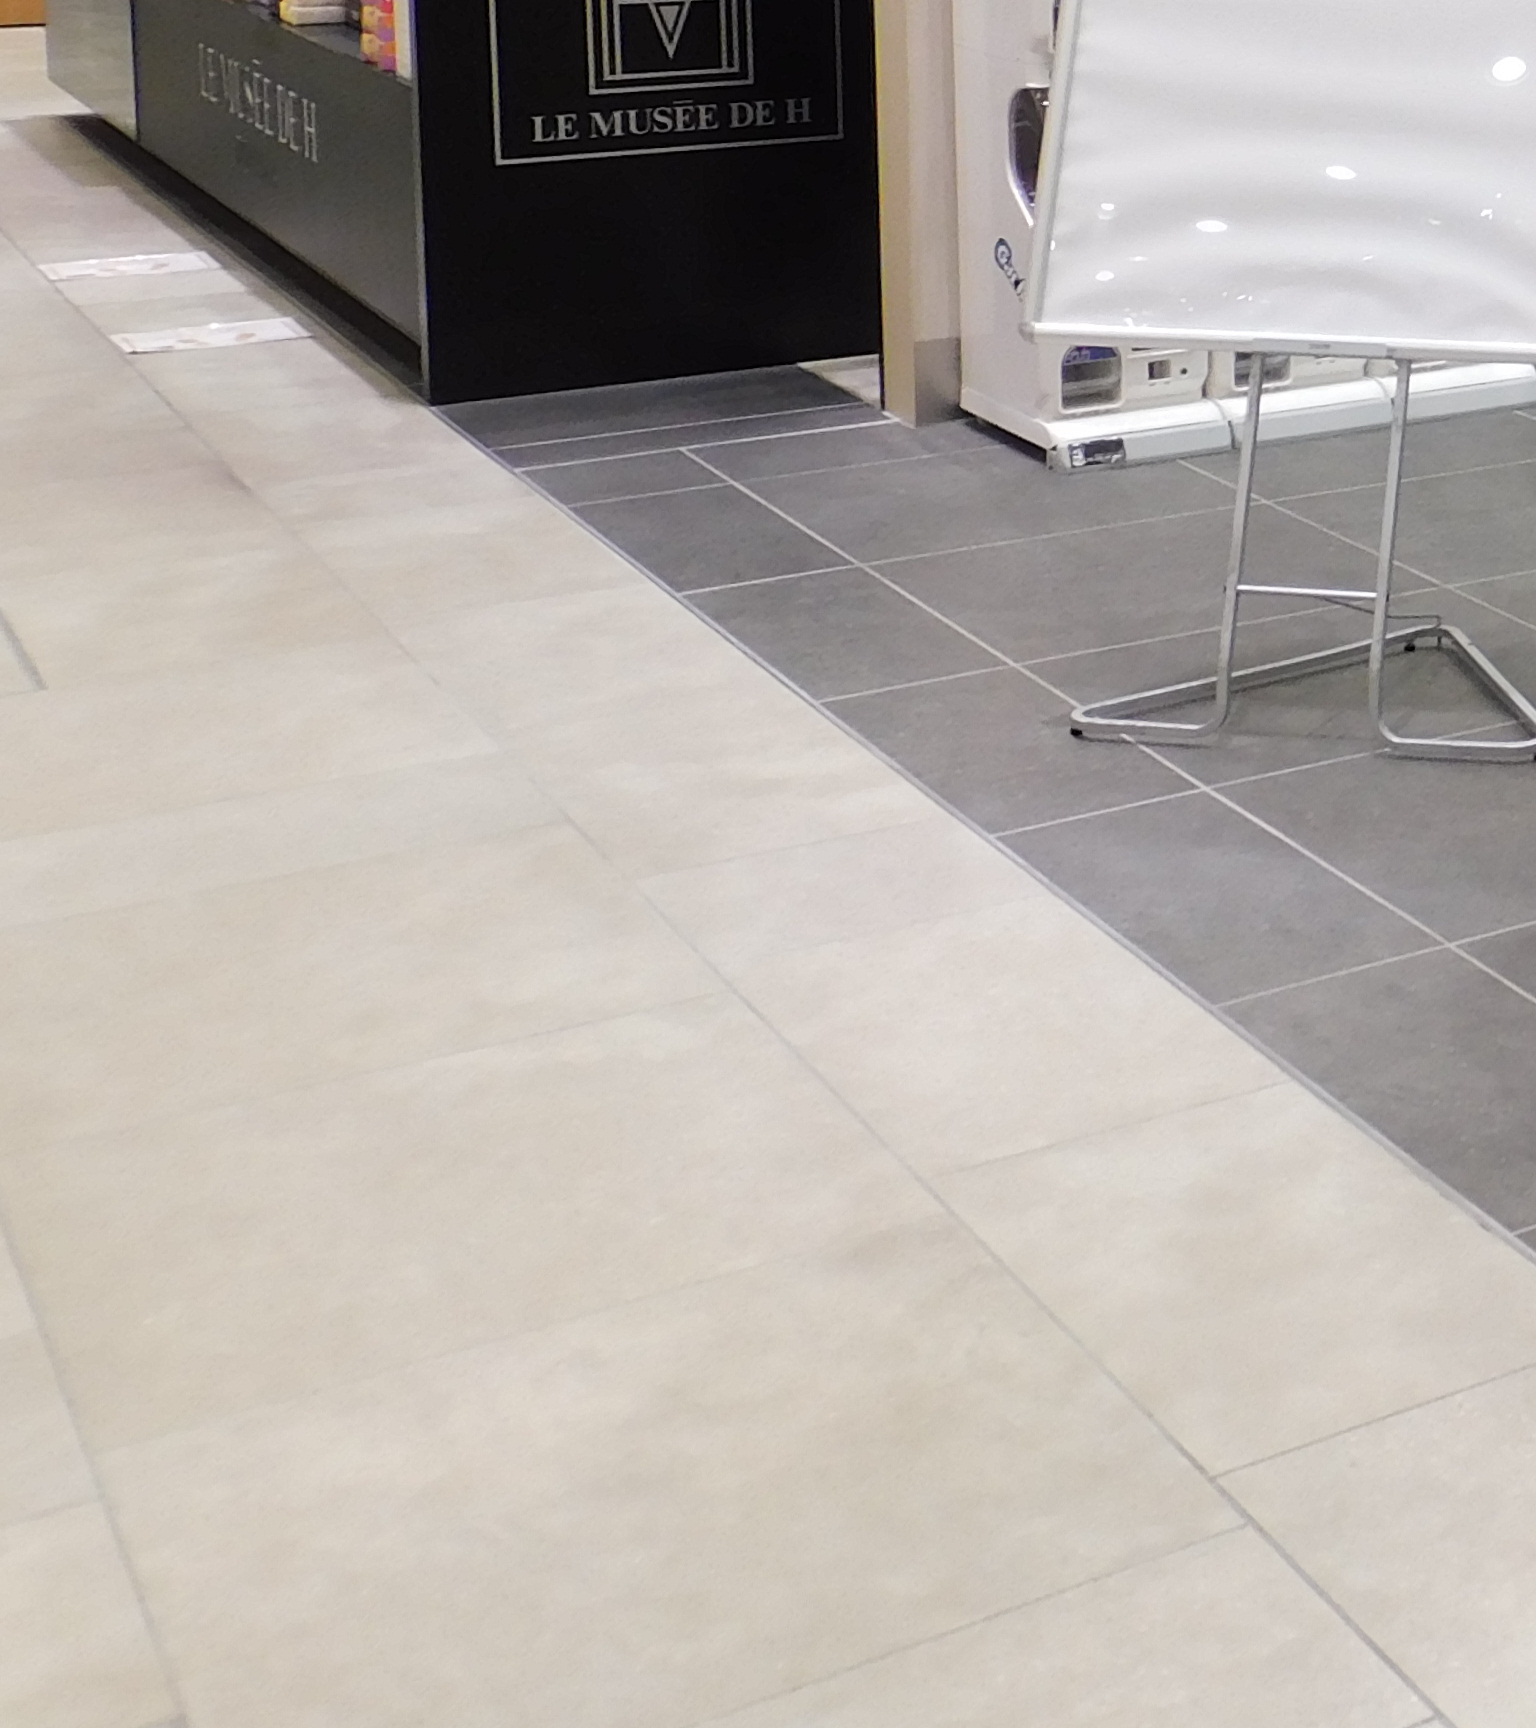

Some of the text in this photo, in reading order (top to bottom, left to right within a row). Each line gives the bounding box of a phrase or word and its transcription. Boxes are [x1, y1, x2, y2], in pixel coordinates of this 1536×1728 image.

[198, 42, 219, 103] LE
[276, 83, 299, 152] DE
[301, 97, 319, 163] H
[530, 112, 580, 143] LE
[728, 98, 776, 129] DE
[785, 96, 813, 124] H
